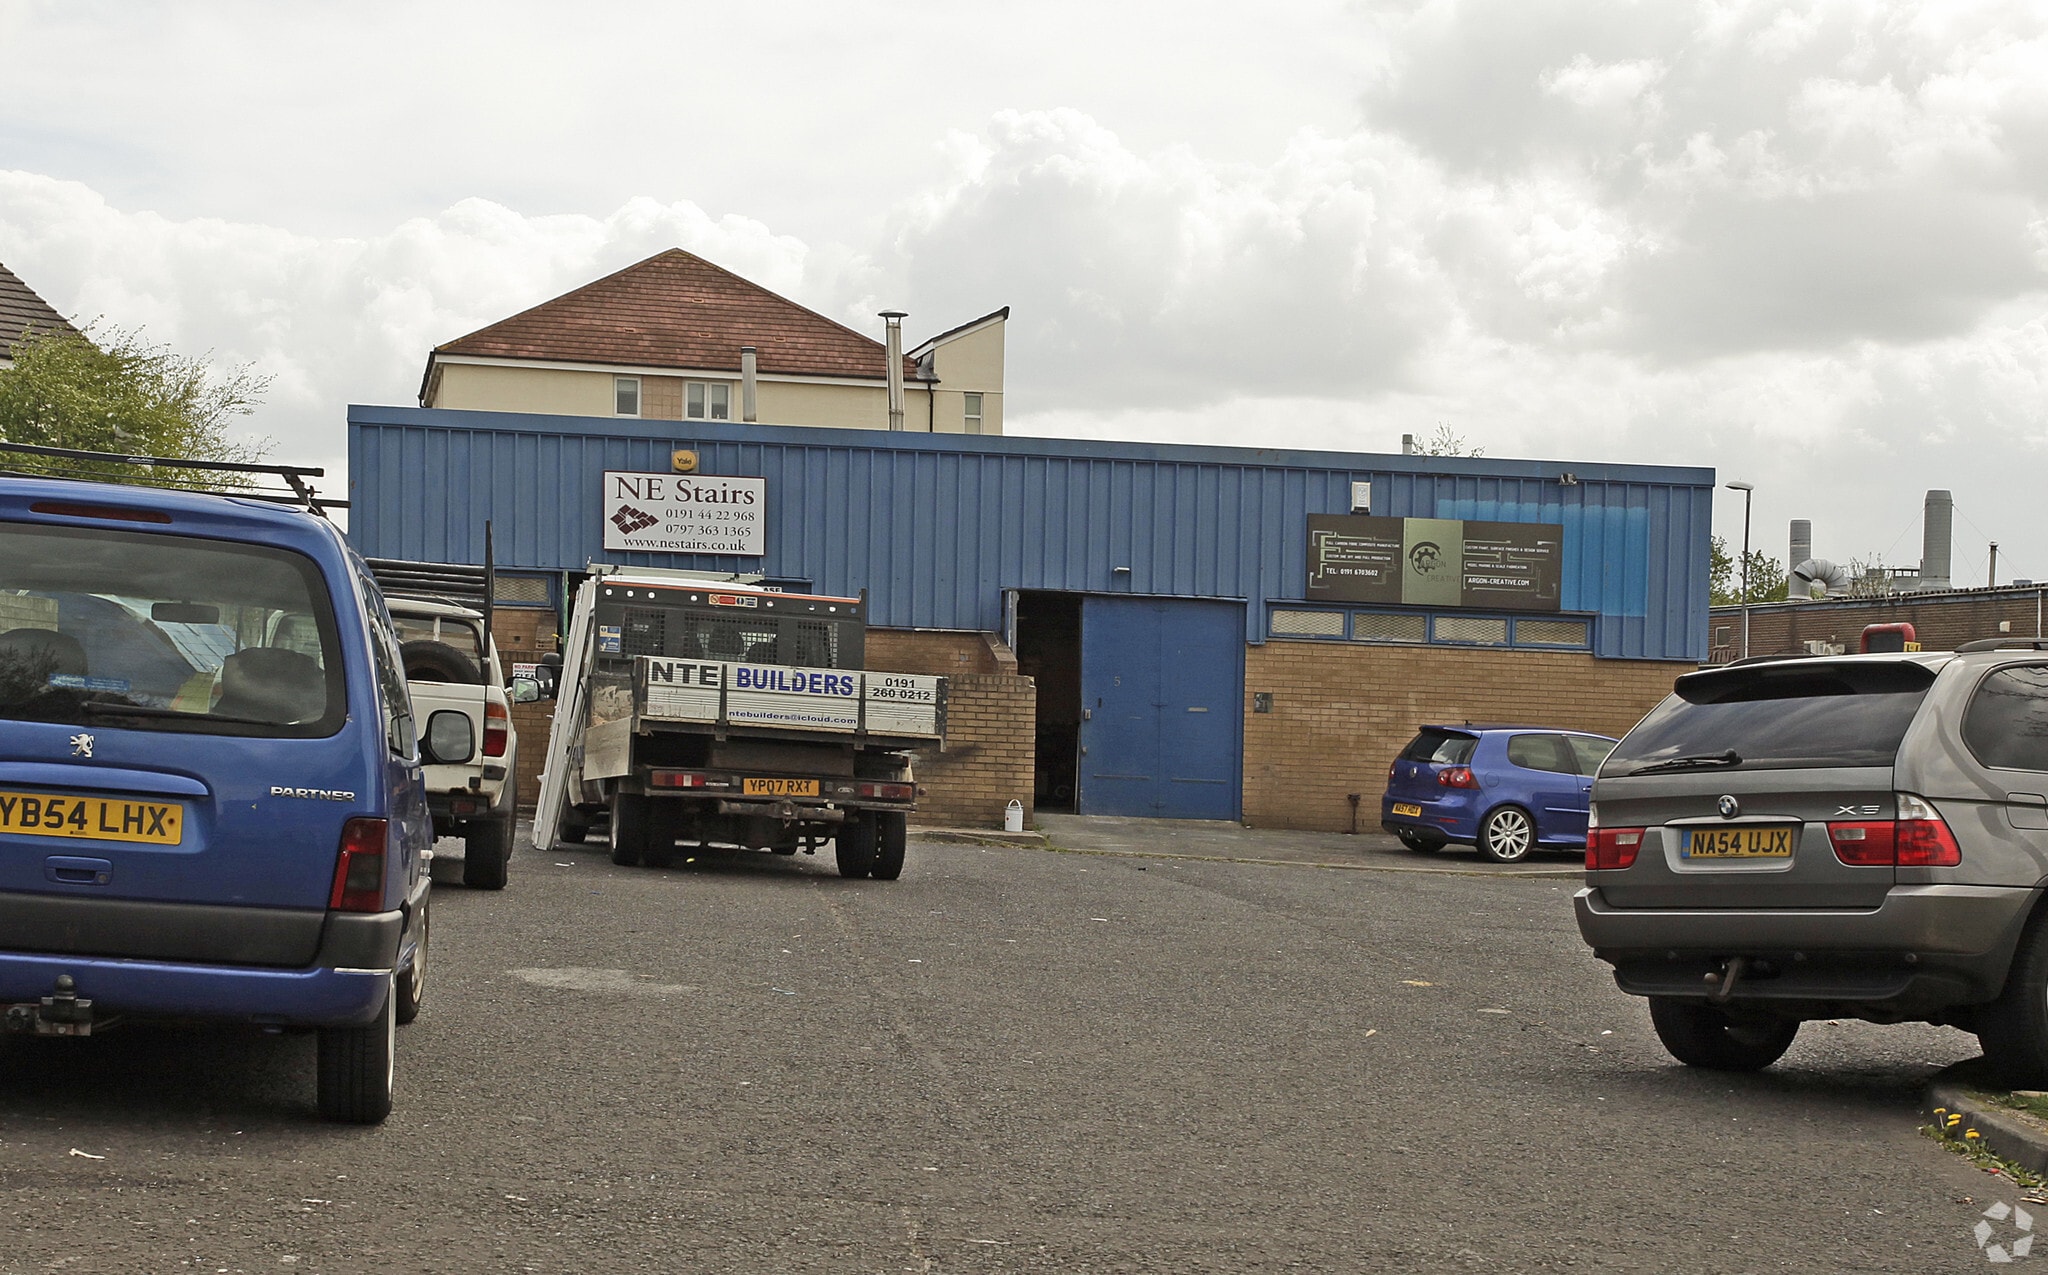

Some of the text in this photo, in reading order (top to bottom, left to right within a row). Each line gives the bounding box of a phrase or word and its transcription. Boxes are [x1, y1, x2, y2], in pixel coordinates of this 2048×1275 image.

[676, 457, 692, 465] Yale
[615, 477, 755, 505] NE Stairs
[666, 508, 755, 522] 0191 44 22 968
[666, 524, 751, 538] 0797 363 1365
[624, 538, 746, 551] www.nestairs.co.uk
[1419, 560, 1447, 568] ARGON
[1427, 575, 1462, 584] CREATIVE
[1467, 577, 1530, 586] ARGON-CREATIVE.COM
[651, 661, 854, 697] NTE BUILDERS
[885, 677, 915, 689] 0191
[872, 688, 931, 701] 260 0212
[729, 710, 857, 724] ntebuilders@icloud.com
[750, 779, 784, 793] YP07
[270, 786, 355, 802] PARTNER
[0, 796, 169, 837] YB54 LHX
[1833, 805, 1881, 816] X5
[1693, 831, 1788, 855] NA54 UJX
